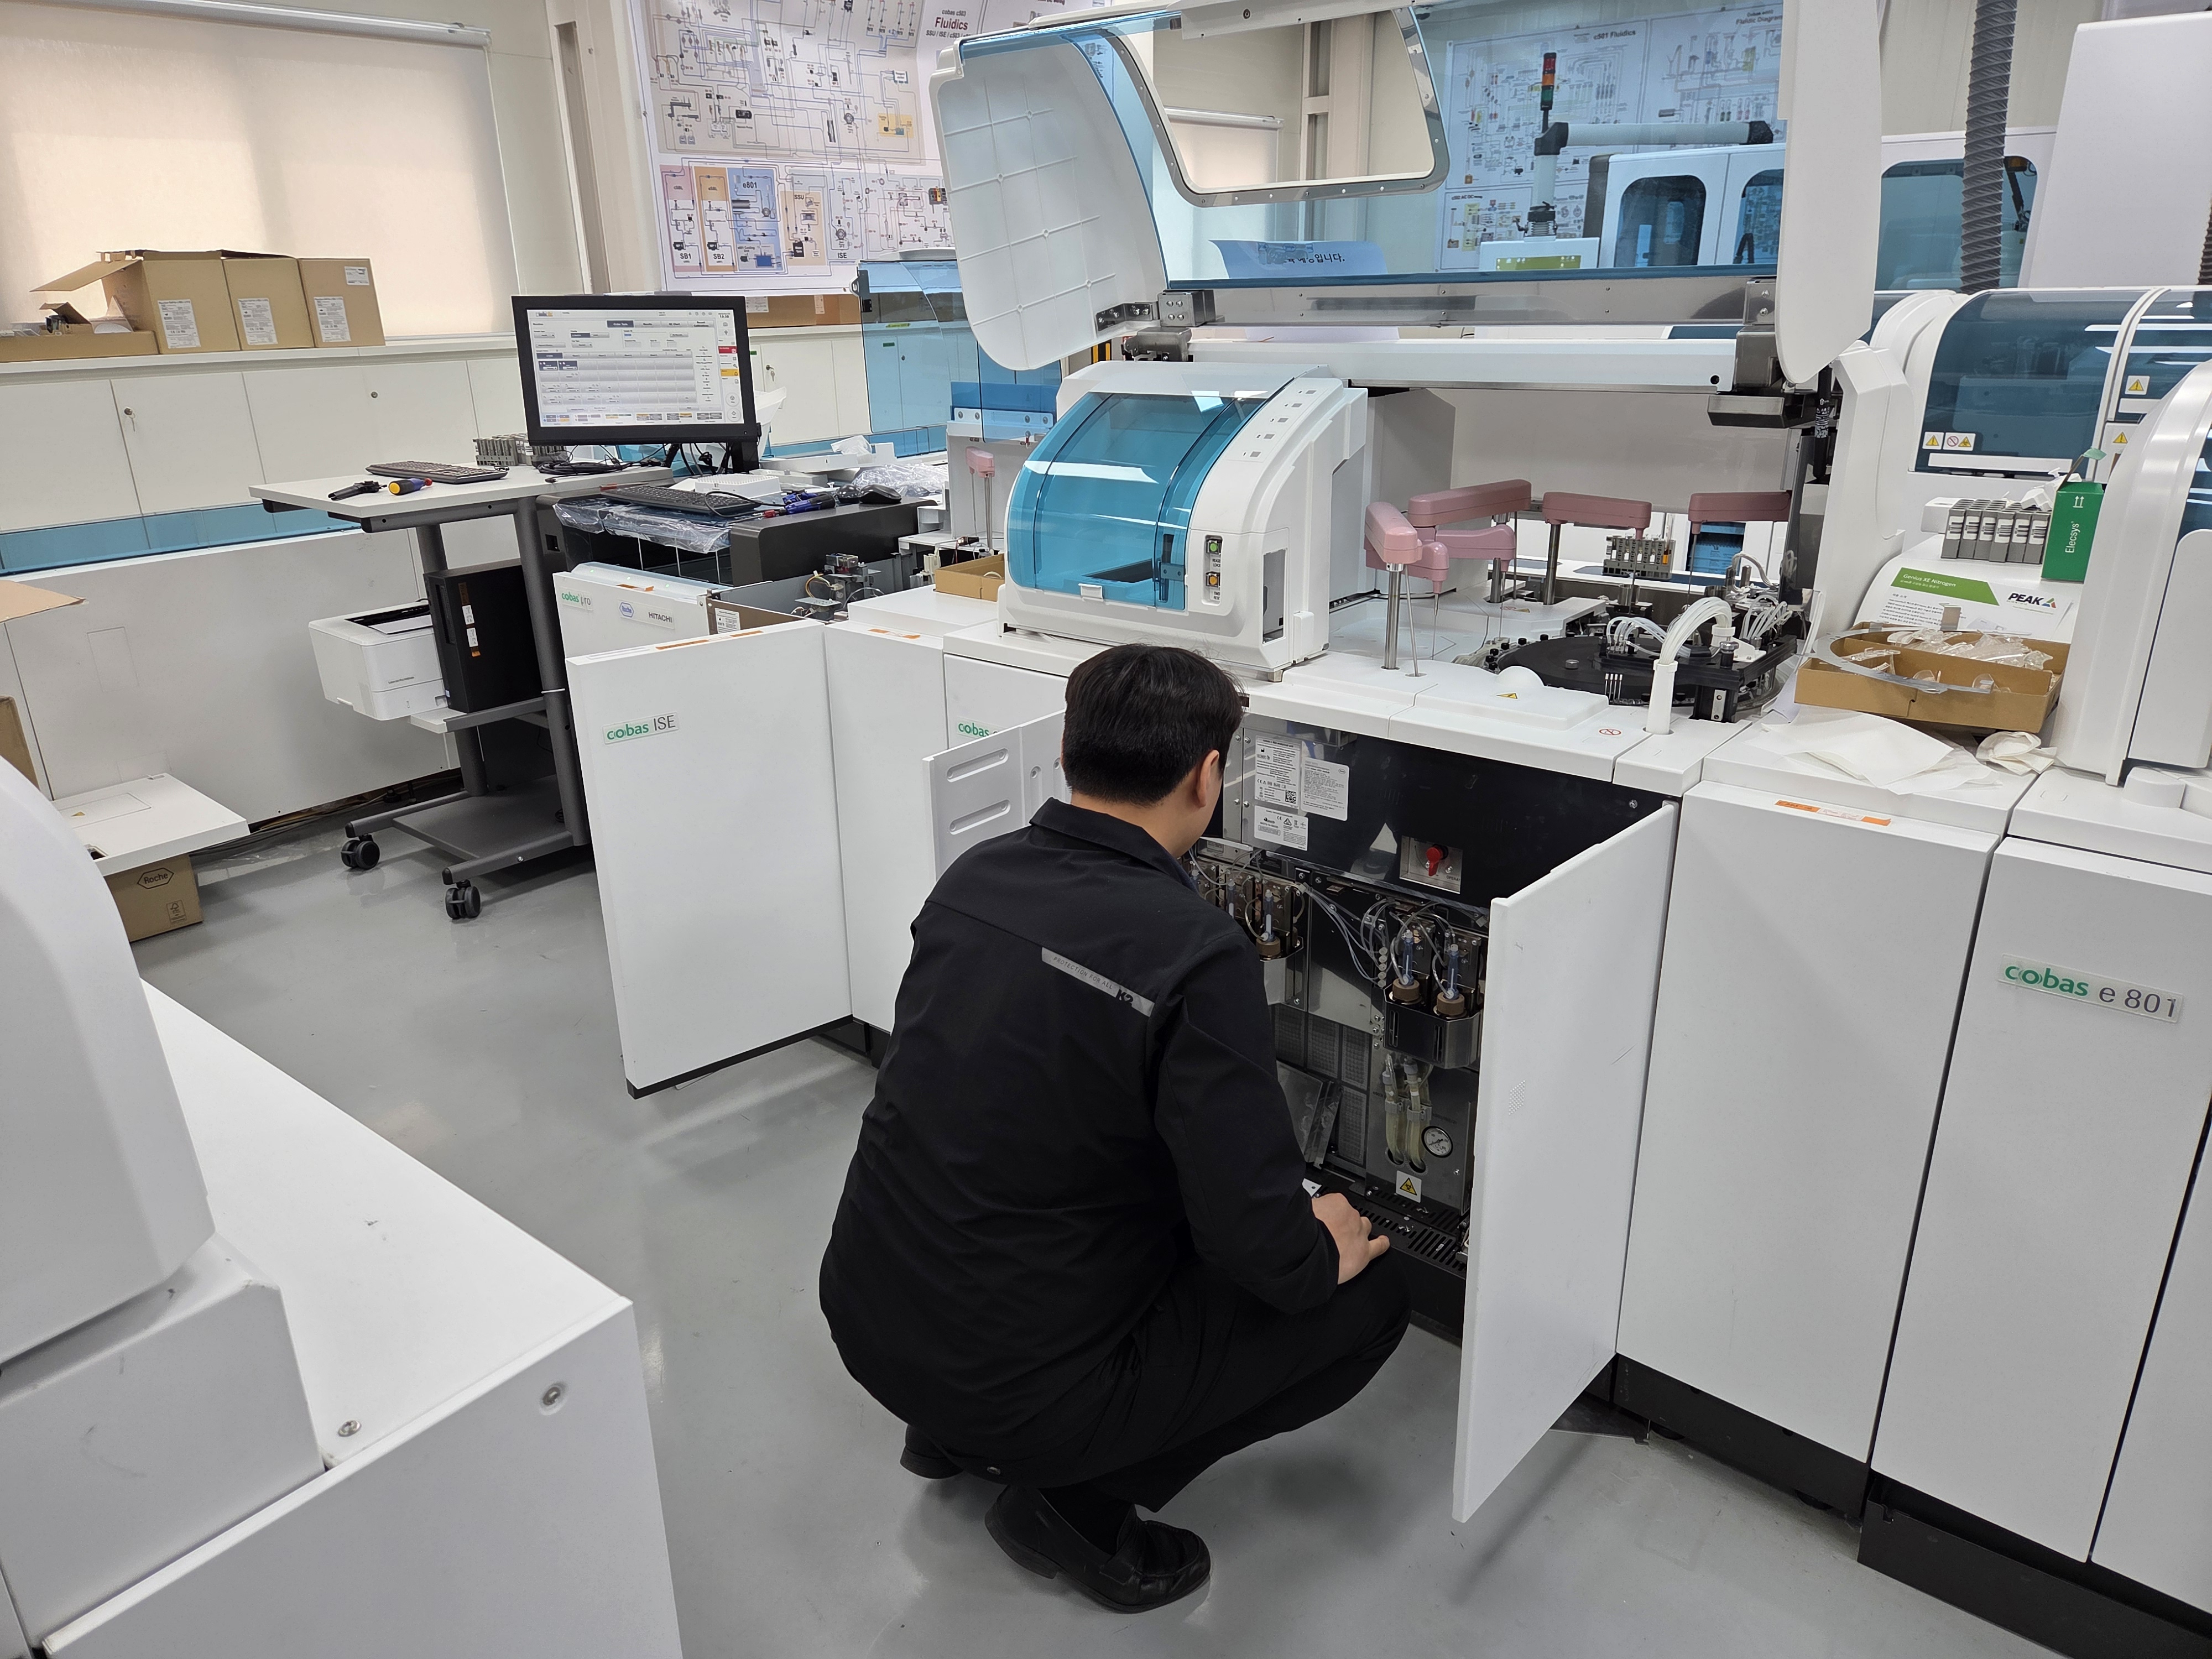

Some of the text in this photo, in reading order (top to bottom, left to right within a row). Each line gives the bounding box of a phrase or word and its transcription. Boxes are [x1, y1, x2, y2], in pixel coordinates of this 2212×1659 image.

[935, 17, 968, 30] Fluidics
[1931, 579, 1957, 587] Nitrogen
[561, 592, 580, 603] cobas
[2008, 592, 2044, 606] PEAK
[648, 612, 672, 623] HITACHI
[607, 714, 676, 740] cobas ISE
[958, 722, 990, 737] cobas
[143, 873, 169, 884] Roche
[1053, 956, 1113, 990] PROTECTION FOR ALL
[1117, 988, 1134, 1005] K2
[2005, 965, 2177, 1018] cobas e 801
